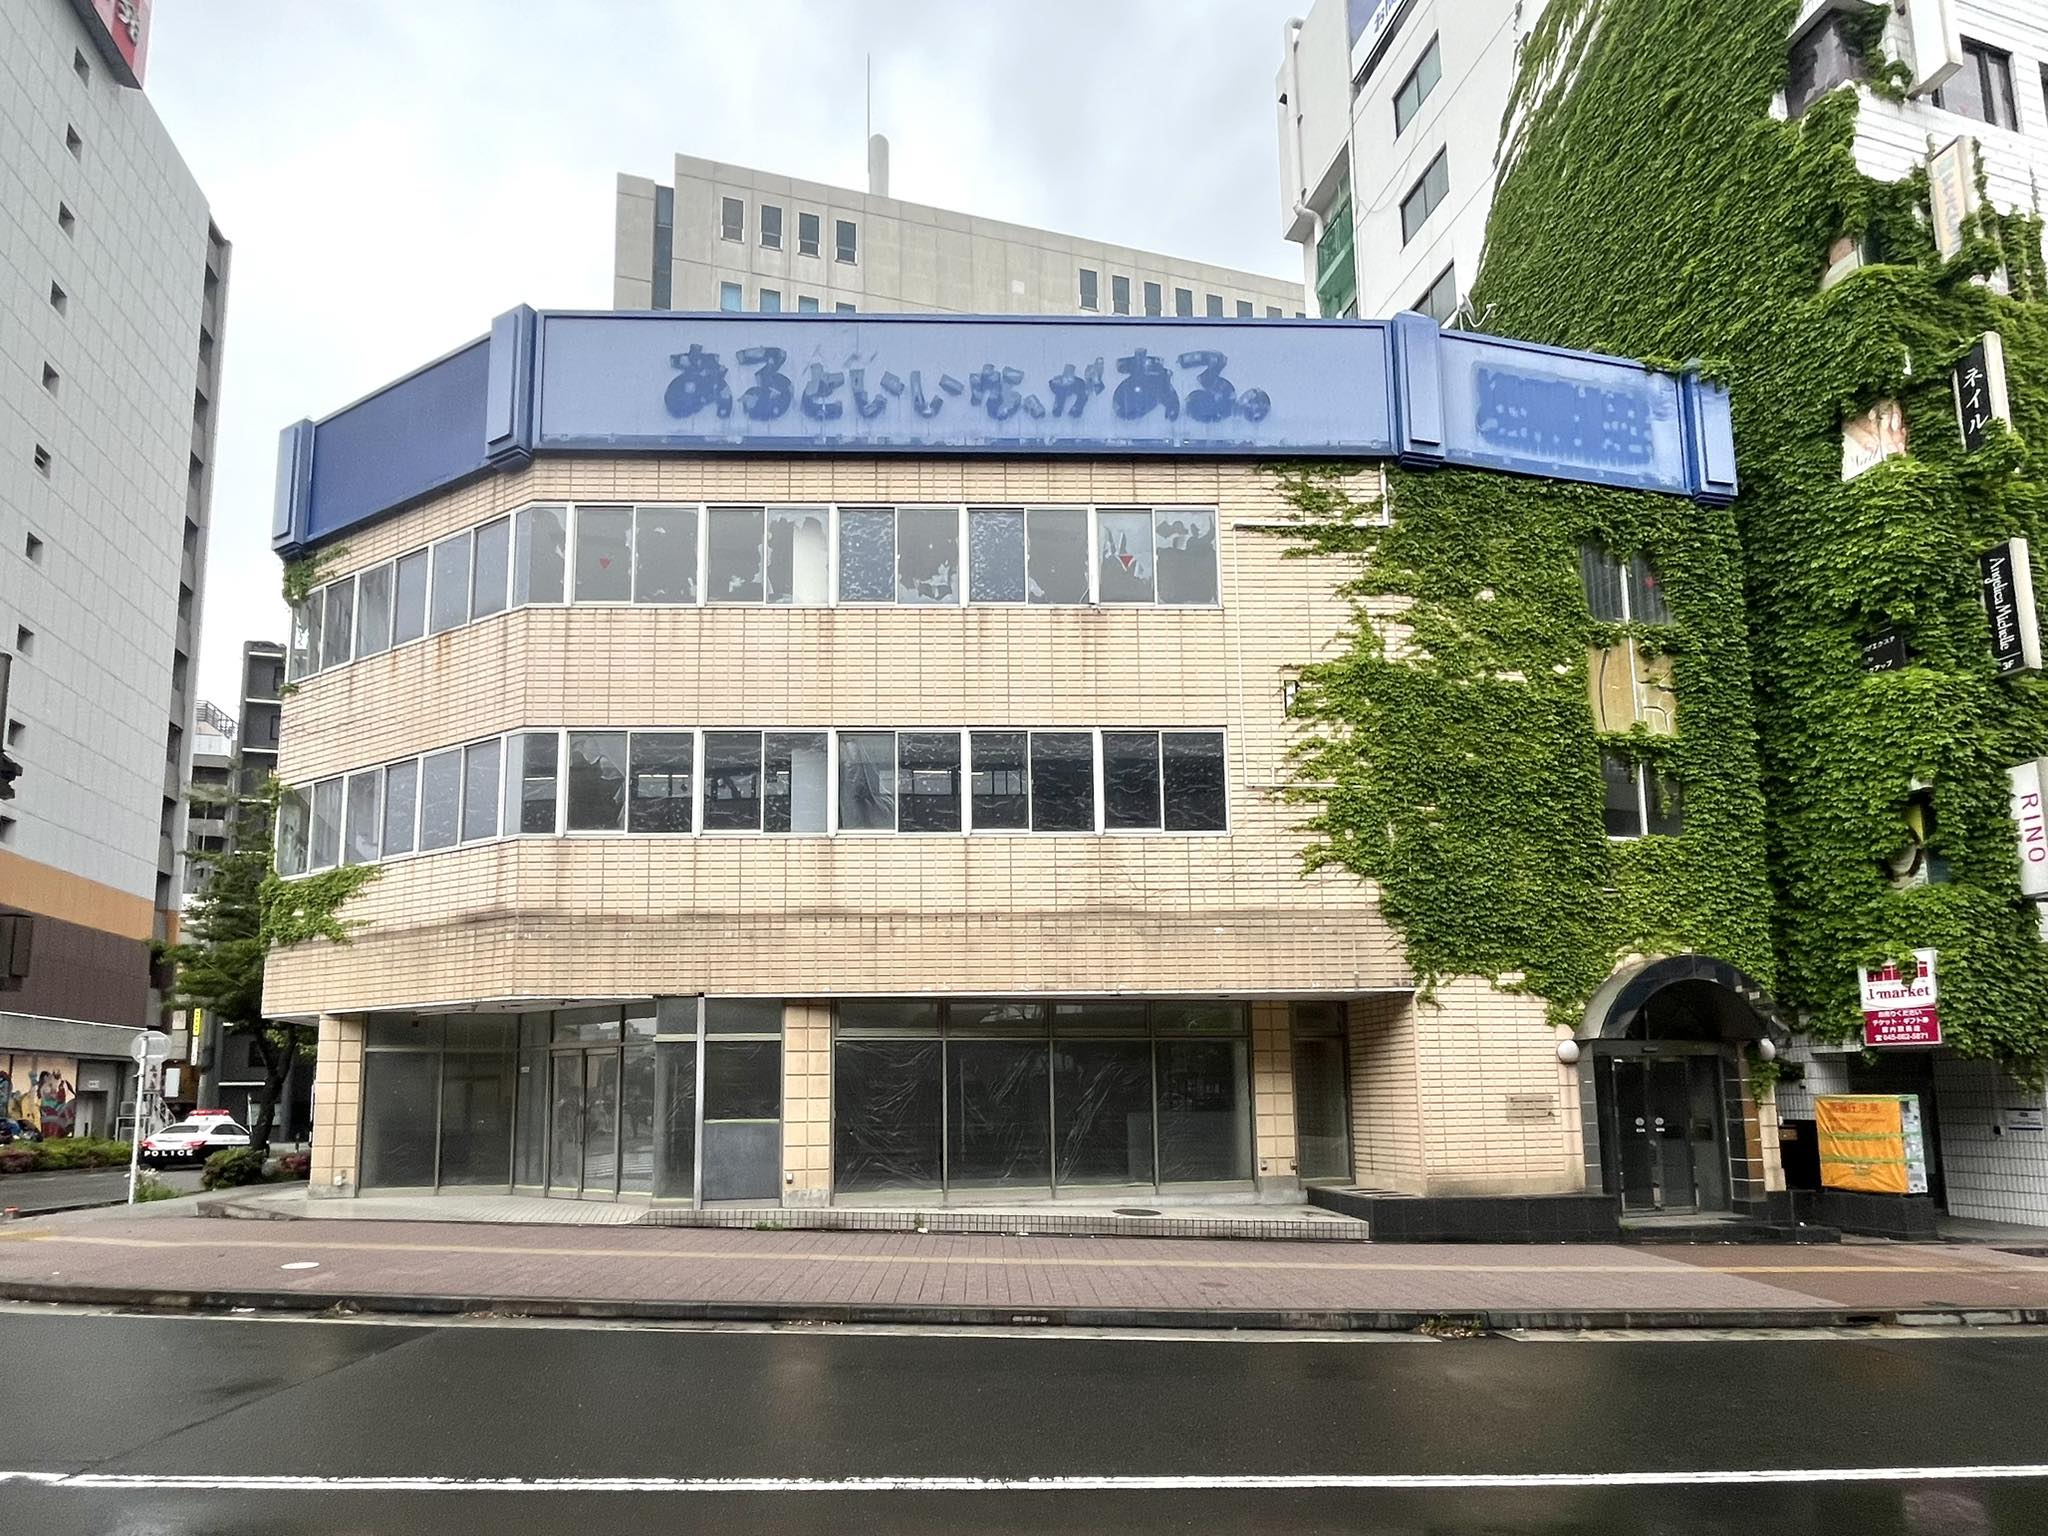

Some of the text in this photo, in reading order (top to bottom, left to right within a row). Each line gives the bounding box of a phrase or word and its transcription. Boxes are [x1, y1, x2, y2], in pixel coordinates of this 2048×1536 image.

[1962, 367, 1988, 435] ネイル
[1984, 557, 2015, 651] Angelica Michelle
[2002, 660, 2015, 671] 3F
[2020, 793, 2046, 862] RINO
[1876, 986, 1931, 999] market
